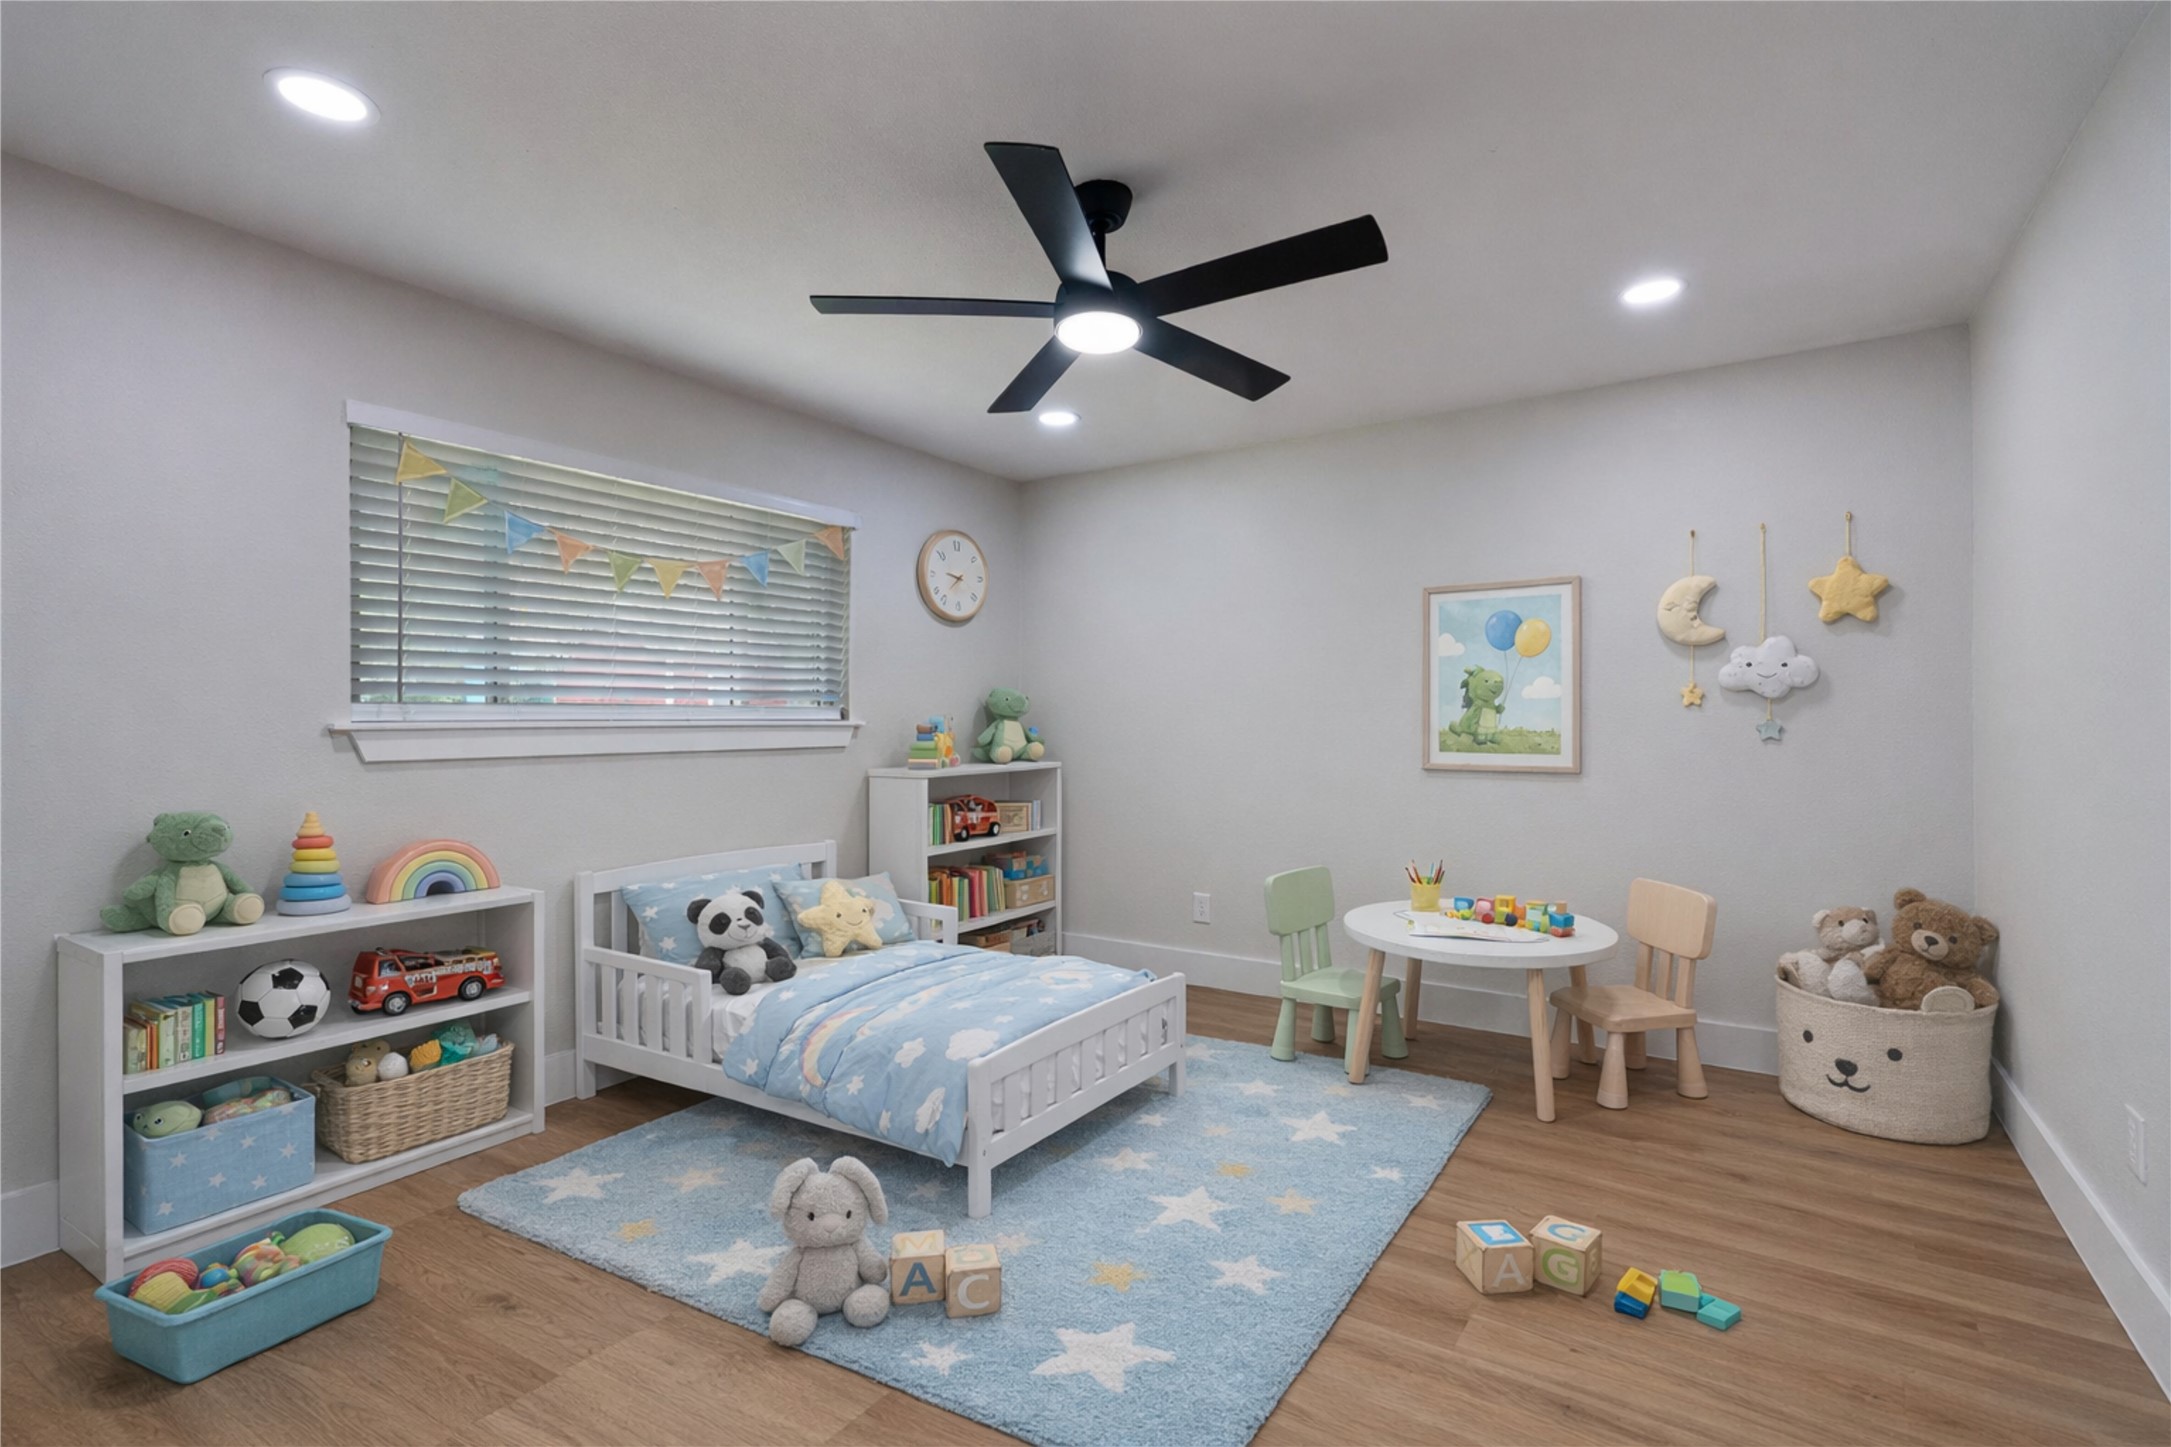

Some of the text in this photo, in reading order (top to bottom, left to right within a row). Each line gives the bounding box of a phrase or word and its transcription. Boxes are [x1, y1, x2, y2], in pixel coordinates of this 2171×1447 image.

[899, 1261, 937, 1297] A
[1491, 1253, 1526, 1288] A
[1546, 1252, 1579, 1285] G
[957, 1273, 991, 1310] C
